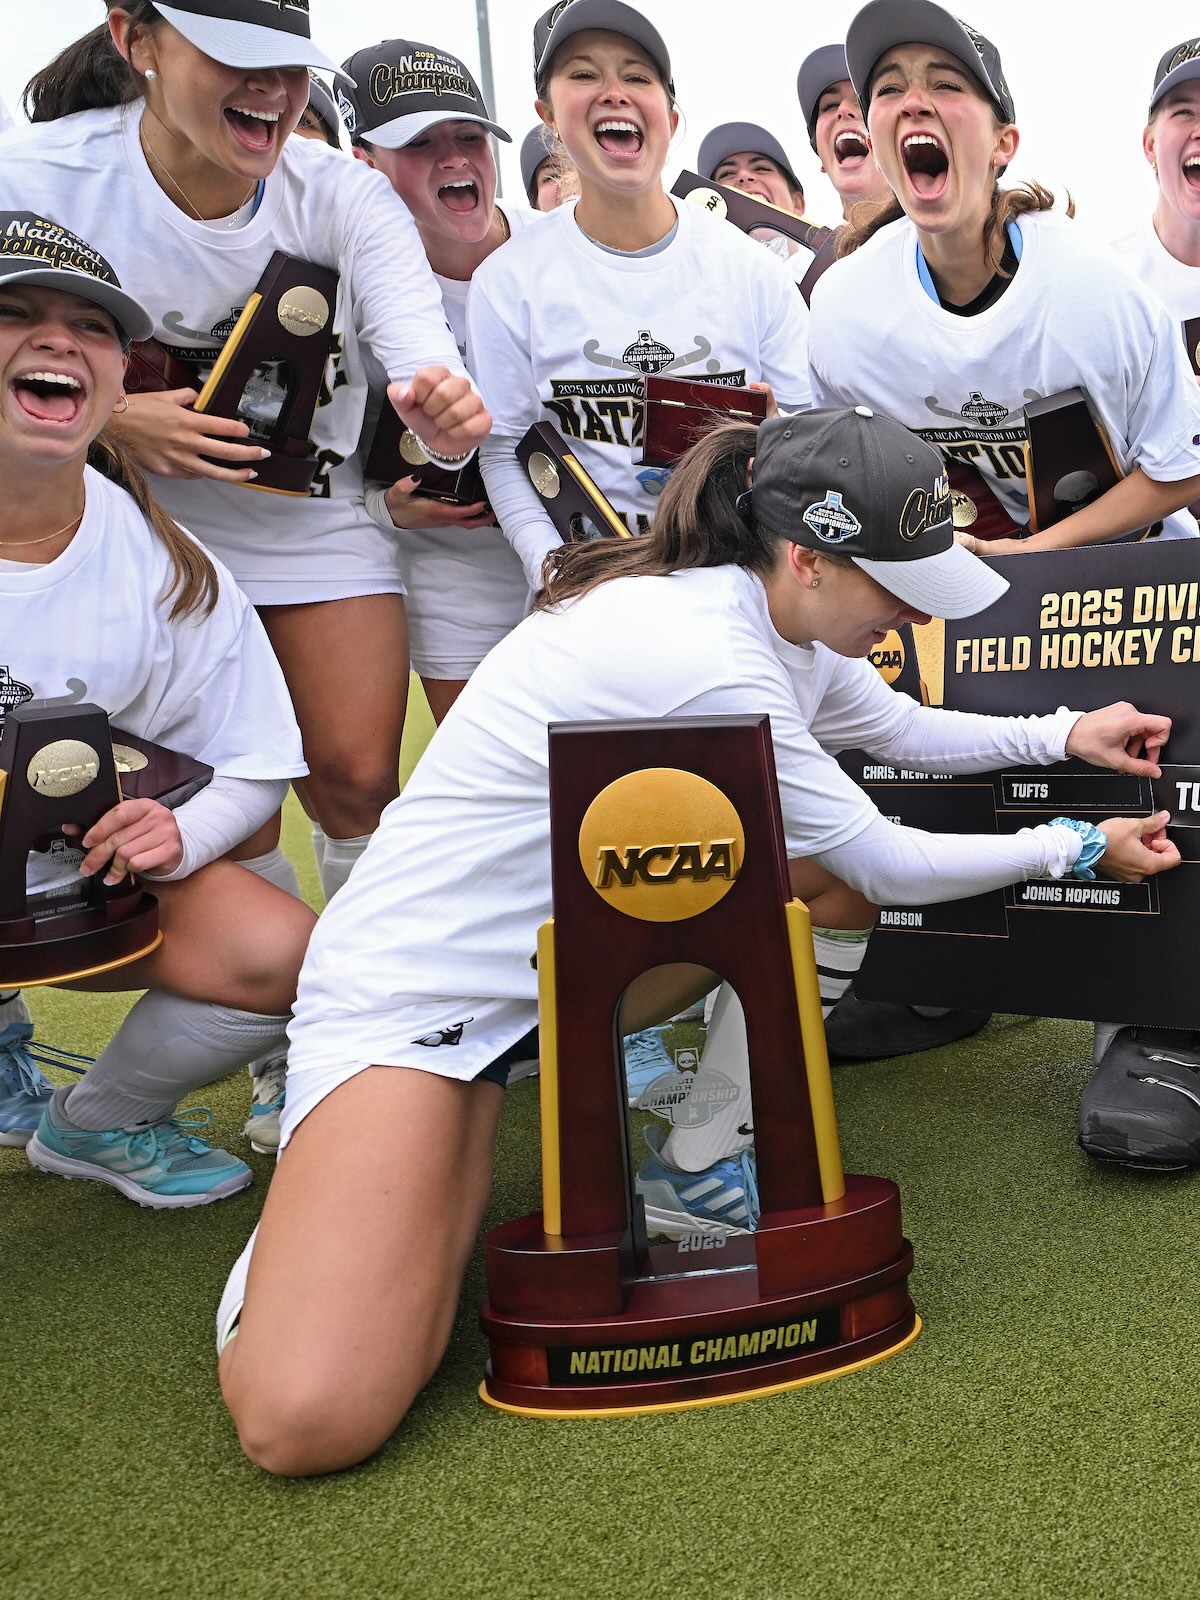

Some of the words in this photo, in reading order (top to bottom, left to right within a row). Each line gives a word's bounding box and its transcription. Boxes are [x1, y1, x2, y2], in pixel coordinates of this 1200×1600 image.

[415, 51, 436, 59] 2025
[399, 55, 463, 78] National
[369, 63, 477, 107] Champions
[7, 220, 103, 267] National
[623, 353, 674, 363] CHAMPIONSHIP
[557, 384, 584, 395] 2025
[585, 383, 616, 395] NCAA
[935, 430, 963, 441] NCAA
[963, 429, 1005, 441] DIVISION
[805, 512, 858, 531] CHAMPIONSHIP
[1039, 587, 1124, 629] 2025
[867, 650, 902, 669] CAA
[955, 635, 1032, 674] FIELD
[1039, 628, 1163, 670] HOCKEY
[33, 762, 98, 788] NCAA
[863, 765, 899, 780] CHRIS.
[1012, 783, 1049, 799] TUFTS
[595, 837, 738, 889] NCAA
[1022, 885, 1062, 902] JOHNS
[1065, 888, 1121, 905] HOPKINS
[880, 910, 923, 927] BABSON
[569, 1343, 683, 1375] NATIONAL
[689, 1318, 818, 1365] CHAMPION
